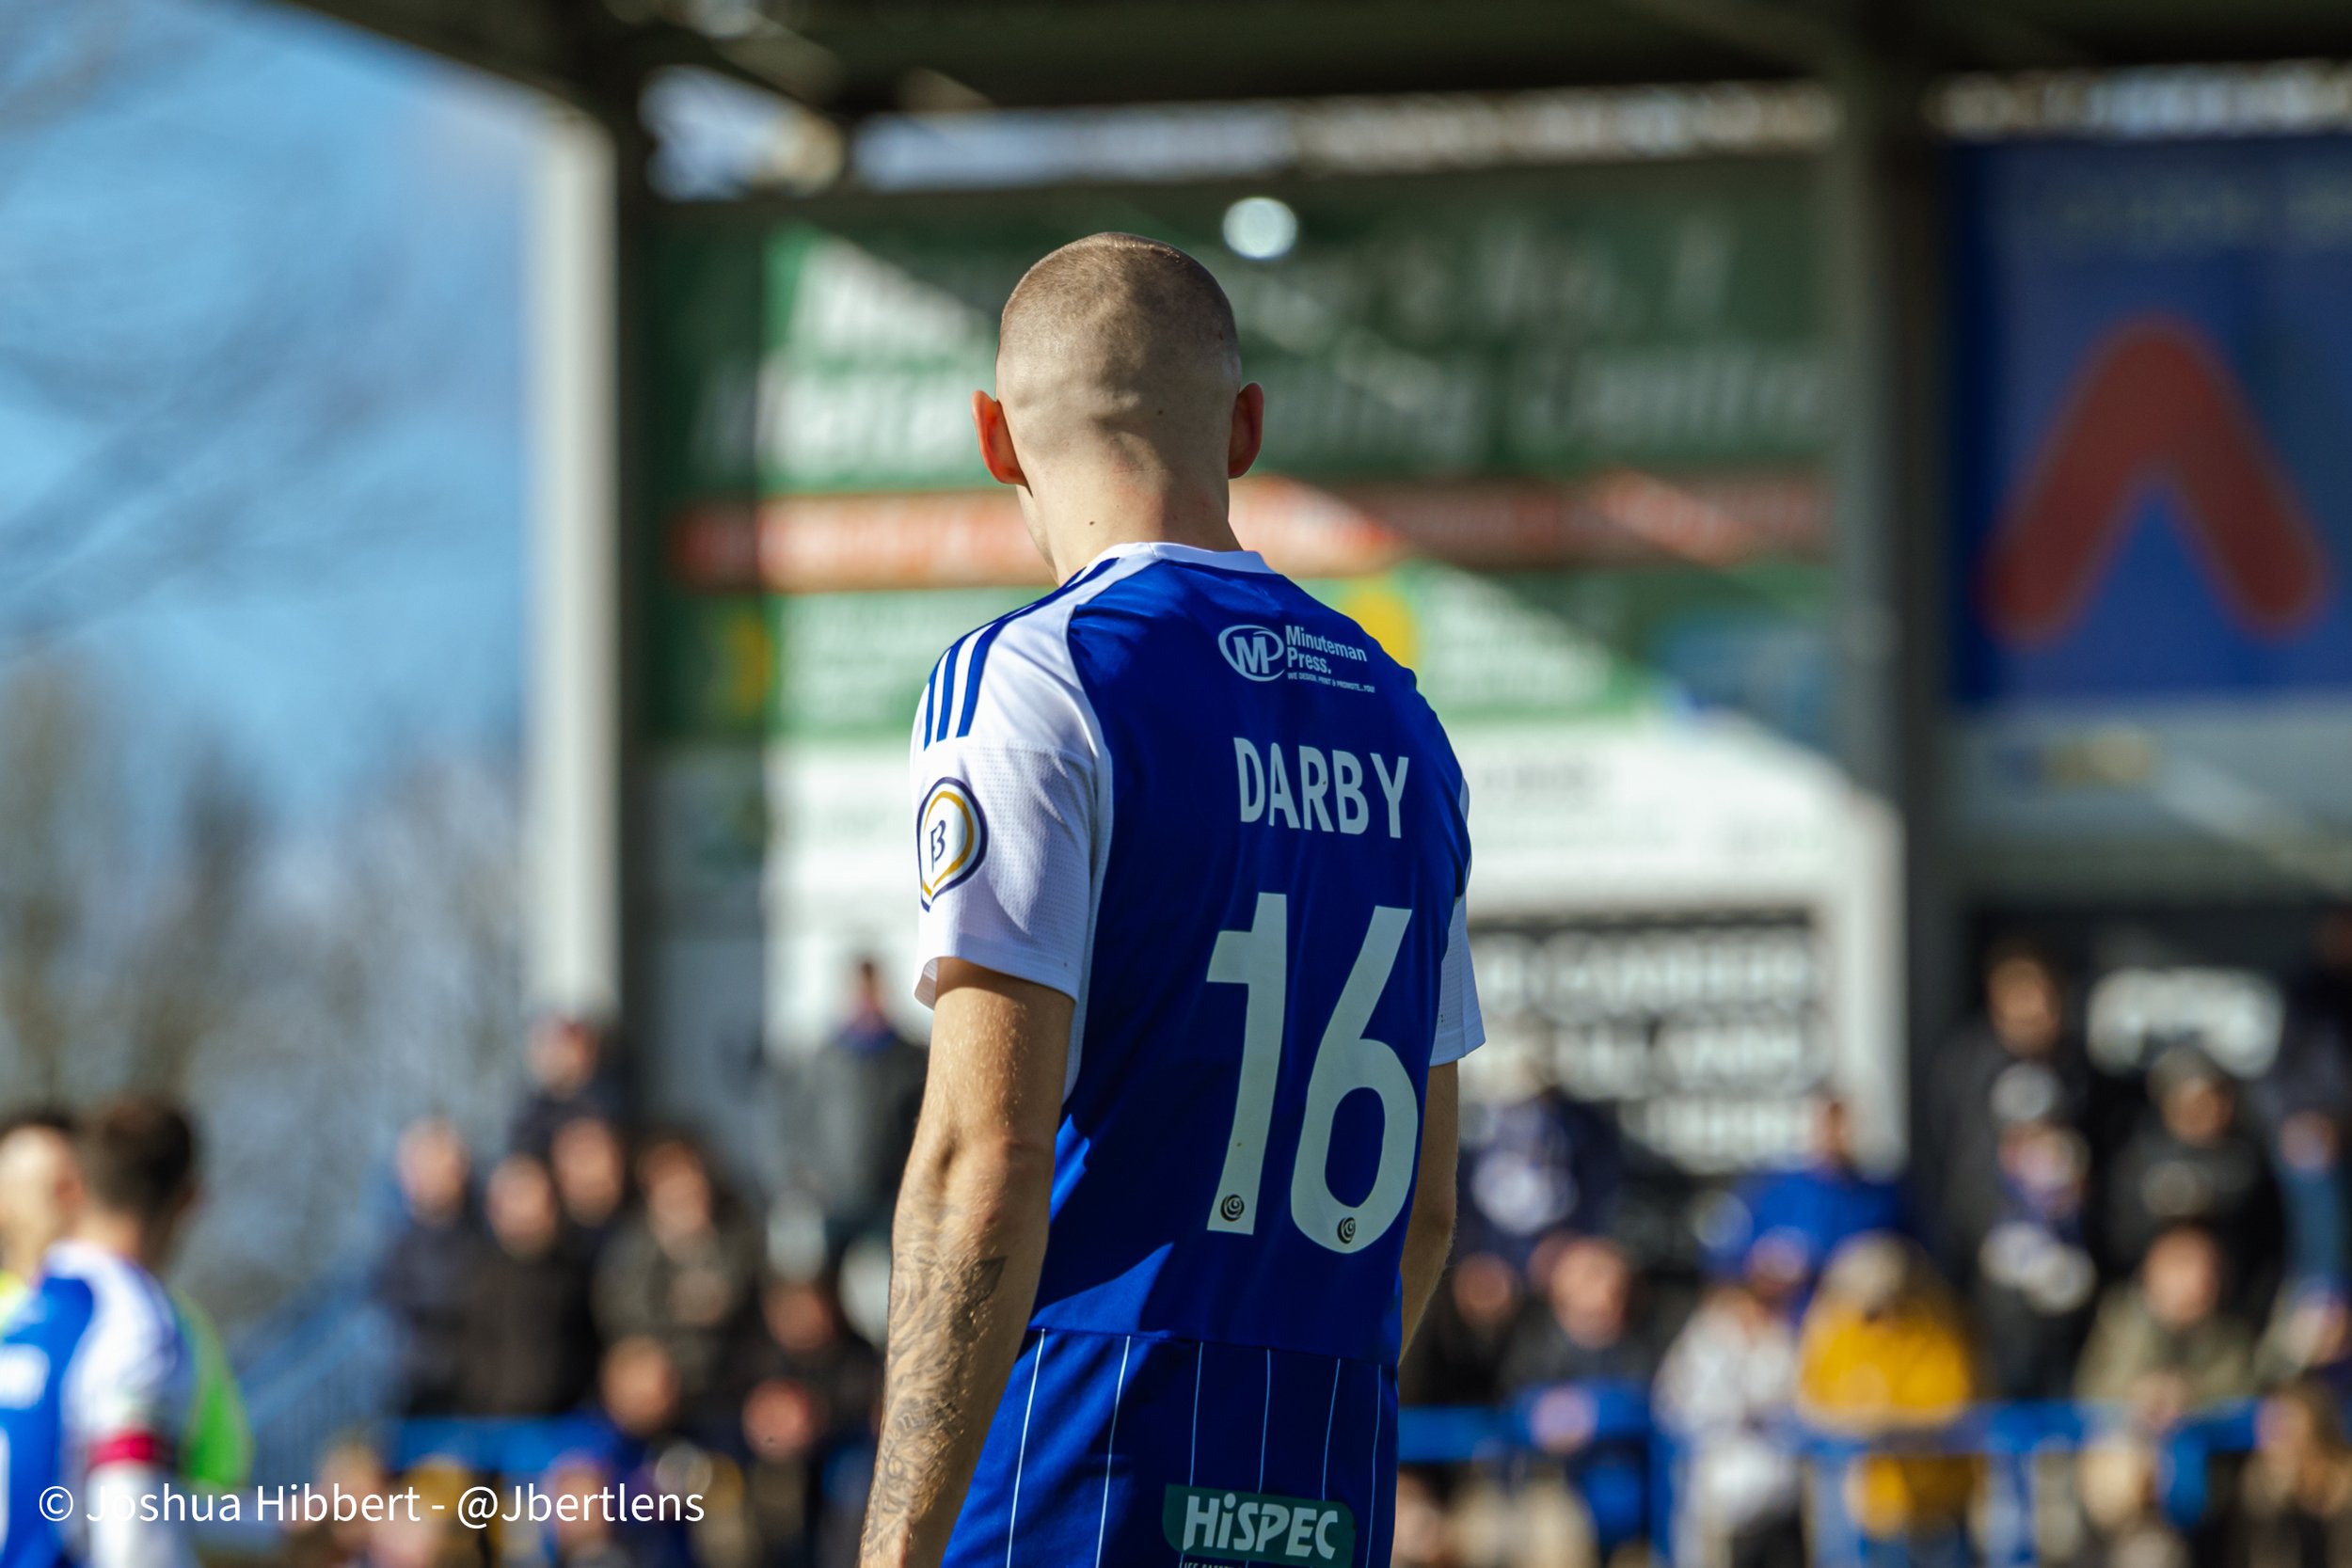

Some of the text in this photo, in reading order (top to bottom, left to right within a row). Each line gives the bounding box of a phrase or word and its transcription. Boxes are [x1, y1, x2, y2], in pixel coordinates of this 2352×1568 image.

[1285, 625, 1367, 662] Minuteman
[1287, 646, 1331, 674] Press.
[1233, 736, 1409, 839] DARBY
[1206, 892, 1418, 1254] 16
